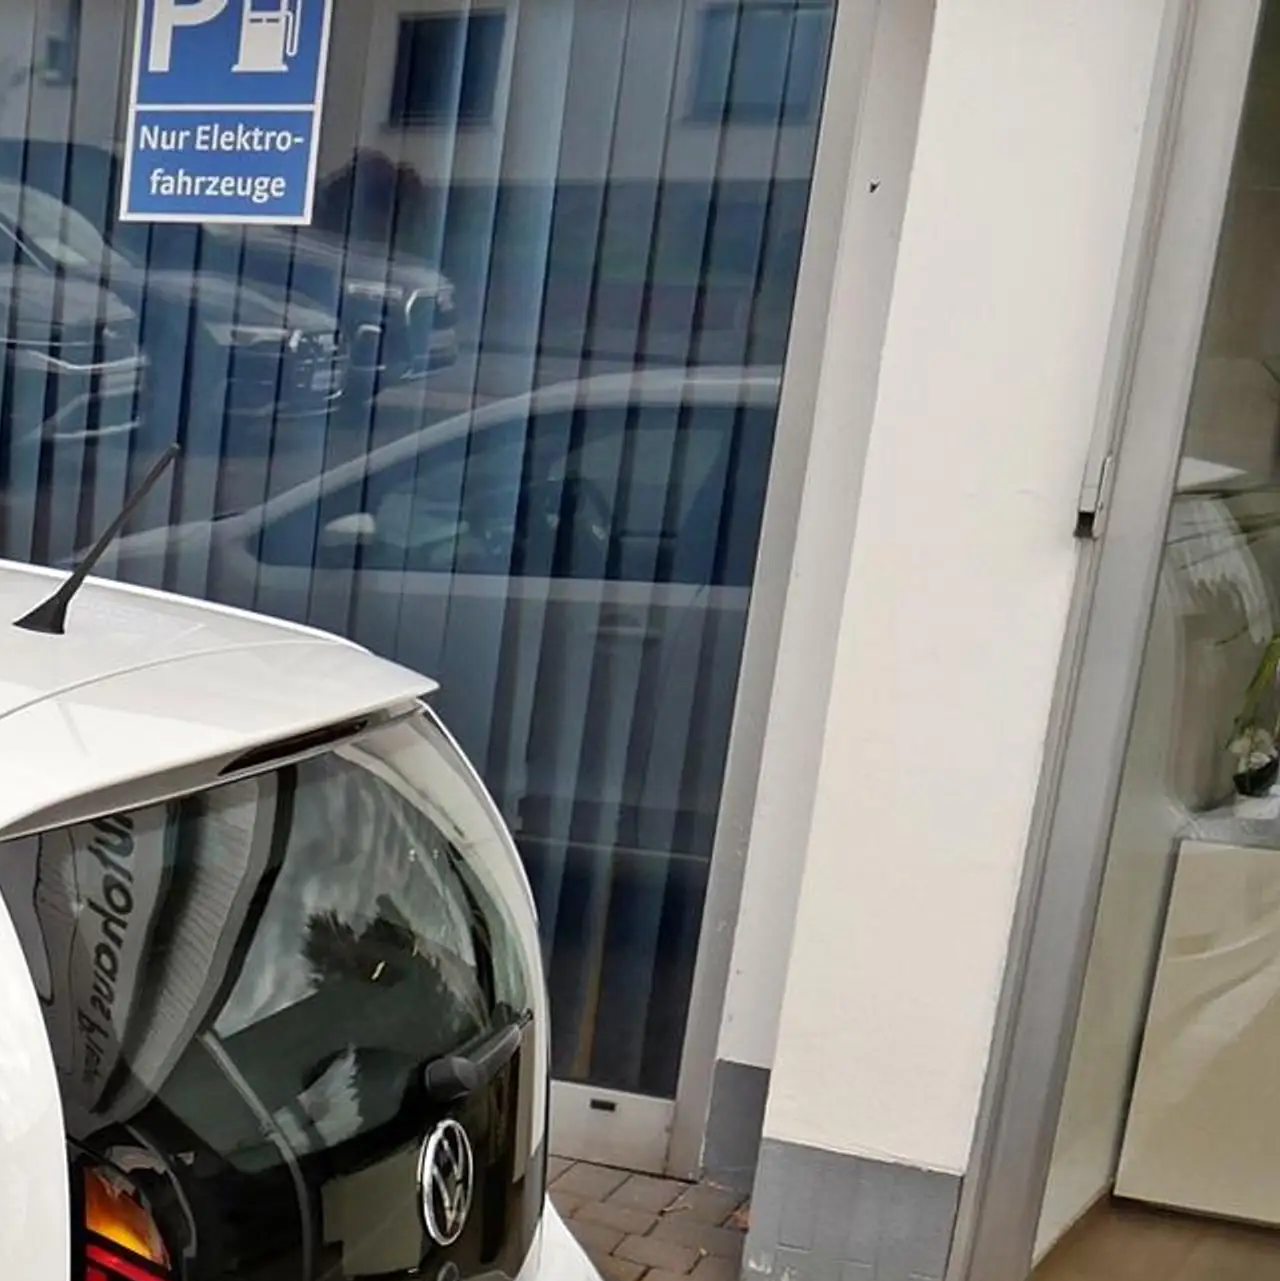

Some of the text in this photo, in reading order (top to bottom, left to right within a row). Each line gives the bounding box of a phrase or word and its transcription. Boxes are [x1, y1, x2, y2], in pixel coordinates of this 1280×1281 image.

[148, 0, 227, 72] P
[139, 122, 305, 151] Nur Elektro-
[150, 168, 286, 203] fahrzeuge
